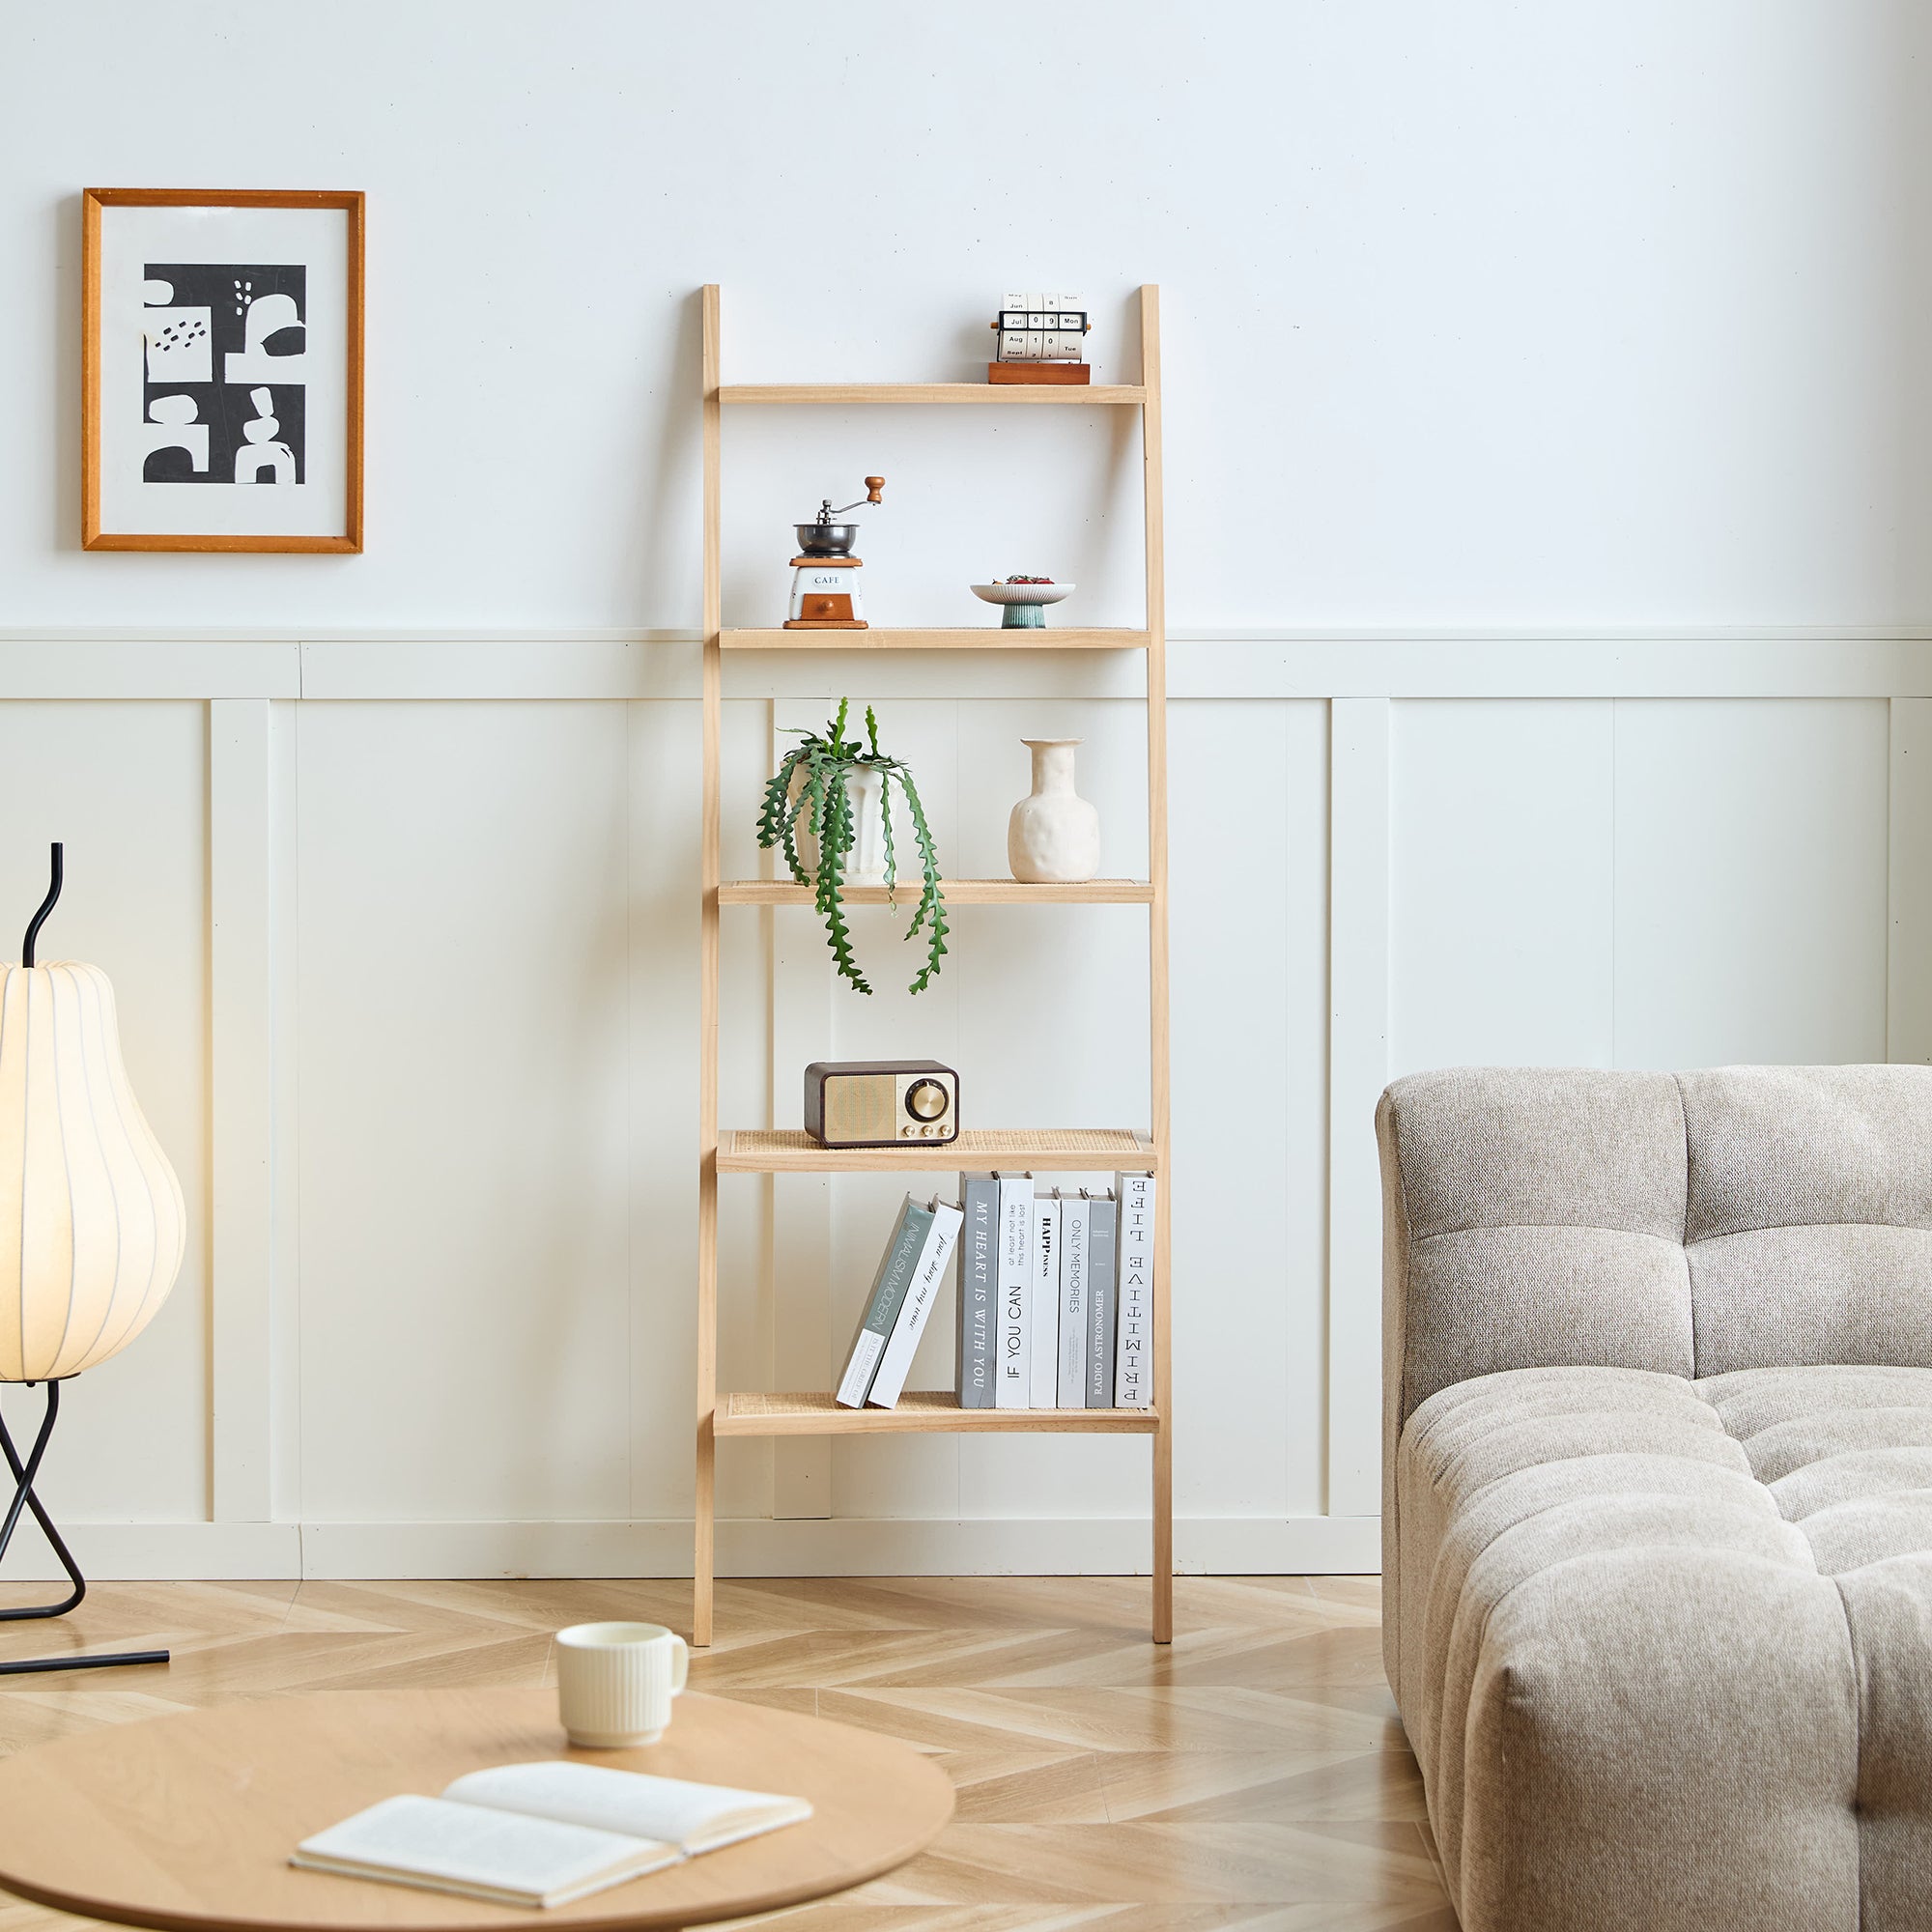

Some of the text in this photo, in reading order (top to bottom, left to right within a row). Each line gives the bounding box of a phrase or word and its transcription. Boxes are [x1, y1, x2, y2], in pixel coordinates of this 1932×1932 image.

[871, 1277, 898, 1331] MODERN
[915, 1288, 927, 1306] my
[973, 1201, 988, 1388] MY HEART IS WITH YOU
[1008, 1258, 1015, 1266] at
[1069, 1219, 1082, 1313] ONLY MEMORIES
[1123, 1180, 1147, 1401] PRIMITIVE LIFE
[1007, 1286, 1022, 1378] IF YOU CAN
[1094, 1290, 1104, 1396] RADIO ASTRONOMER
